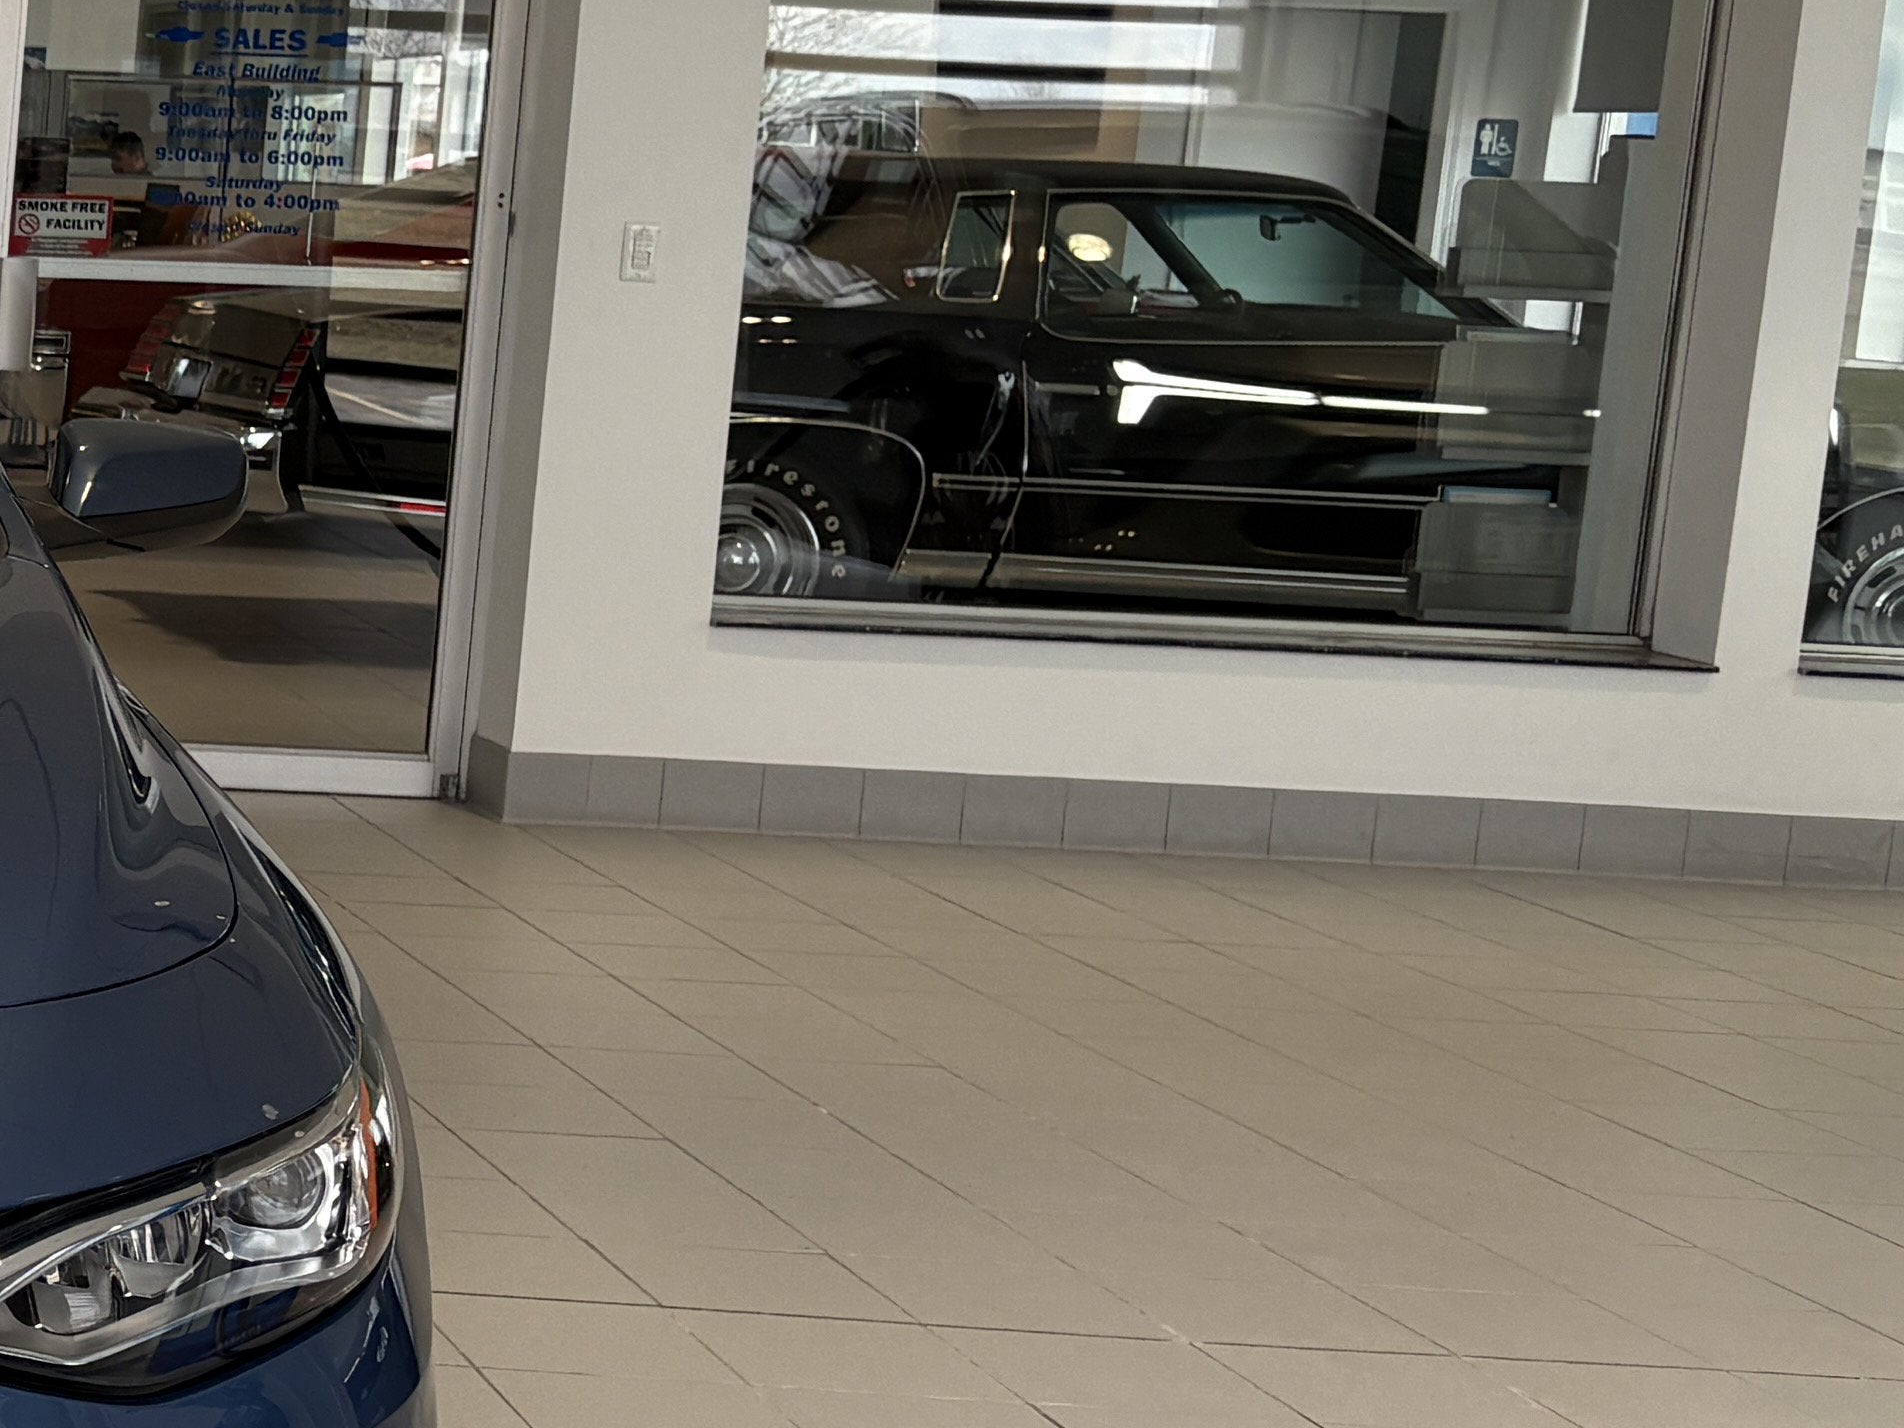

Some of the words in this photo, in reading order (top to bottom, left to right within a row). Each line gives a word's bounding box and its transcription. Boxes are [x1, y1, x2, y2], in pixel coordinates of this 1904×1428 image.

[215, 27, 308, 51] SALES
[193, 60, 236, 78] East
[242, 62, 322, 83] Building
[271, 105, 348, 124] 8:00pm
[283, 130, 337, 146] Friday
[155, 147, 232, 164] 9:00am
[239, 149, 260, 164] to
[267, 150, 344, 169] 6:00pm
[17, 200, 67, 212] SMOKE
[71, 202, 106, 214] FREE
[235, 192, 256, 209] to
[263, 193, 340, 213] 4:00pm
[45, 218, 105, 232] FACILITY
